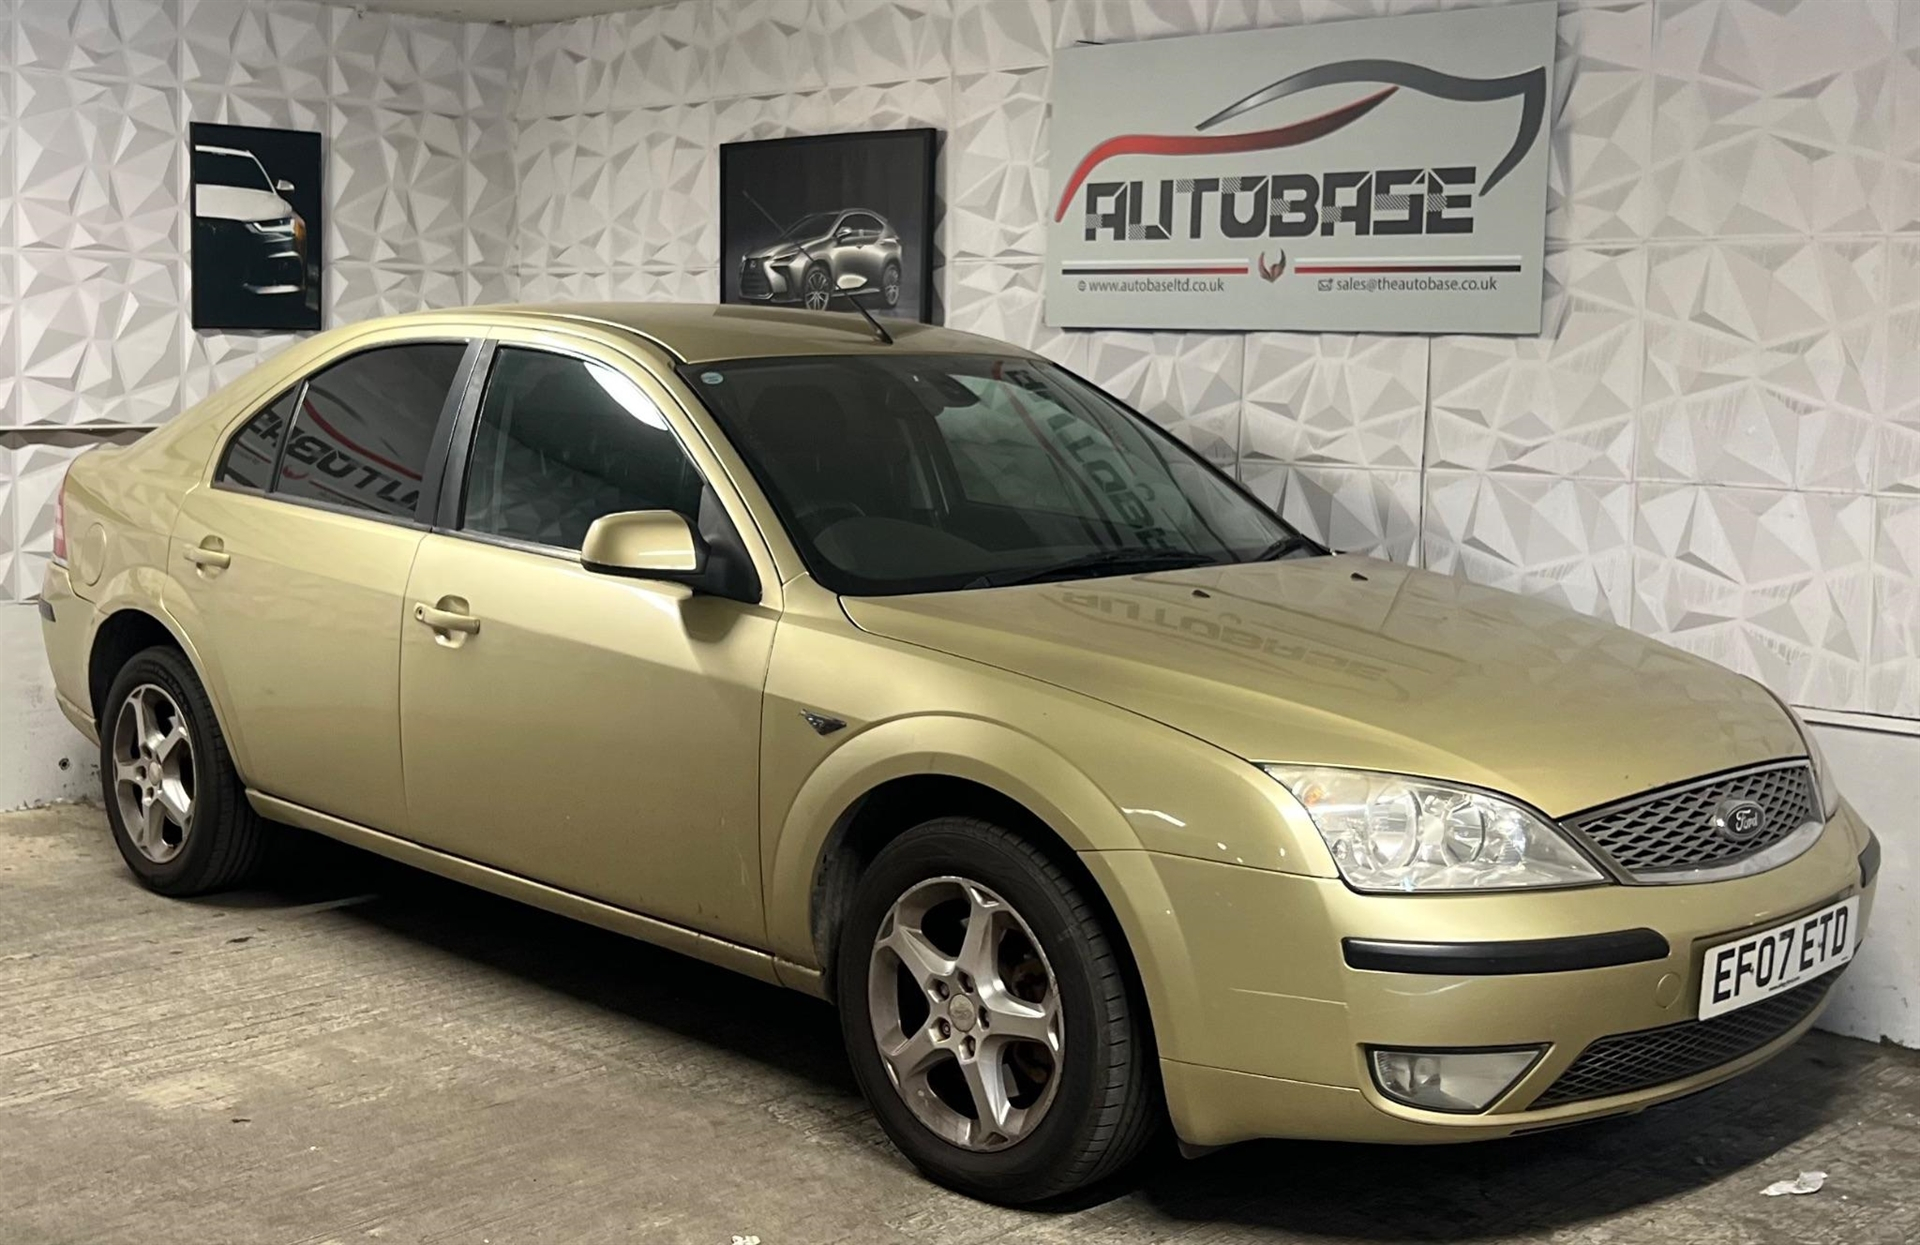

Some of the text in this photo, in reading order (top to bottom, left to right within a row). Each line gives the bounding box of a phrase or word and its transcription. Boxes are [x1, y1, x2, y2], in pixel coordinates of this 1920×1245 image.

[1085, 166, 1476, 241] AUTOBASE
[1089, 278, 1225, 292] www.autobaseltd.co.uk
[1336, 277, 1497, 292] sales@theautobase.co.uk
[1736, 809, 1758, 831] Ford
[1713, 906, 1848, 1004] EF07 ETD
